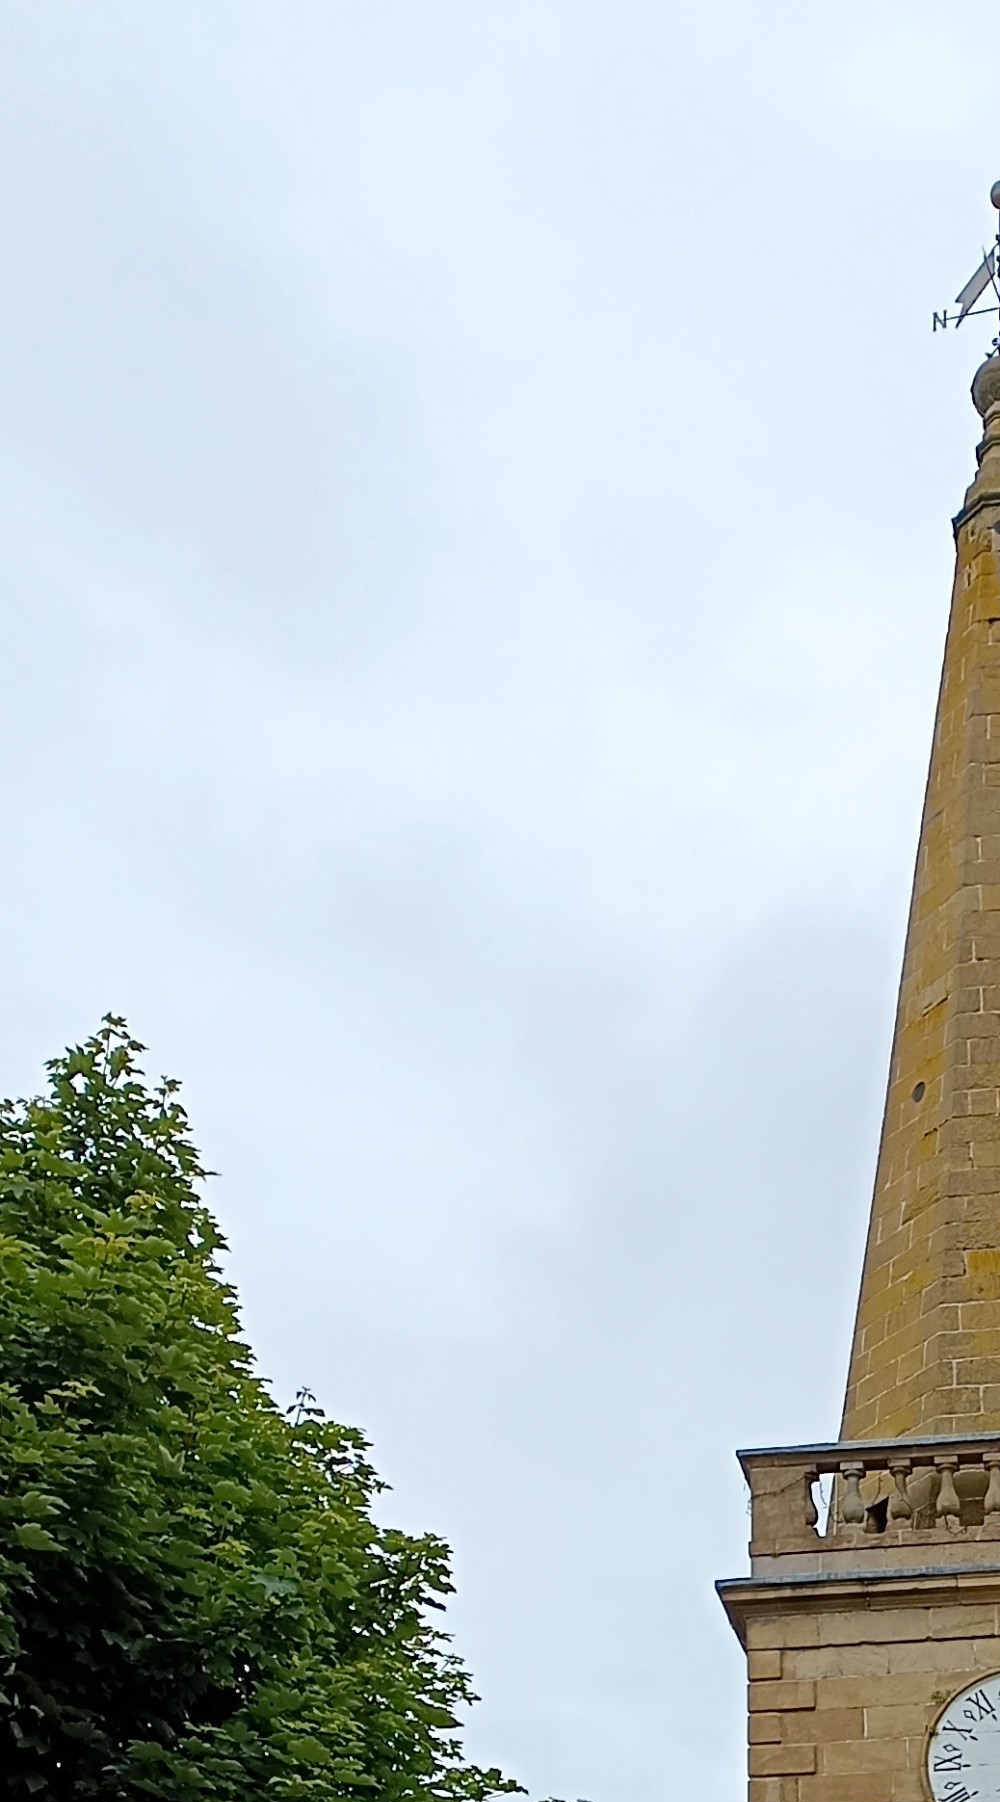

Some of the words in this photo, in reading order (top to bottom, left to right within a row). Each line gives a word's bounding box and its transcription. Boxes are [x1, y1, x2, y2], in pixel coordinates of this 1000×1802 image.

[933, 309, 948, 332] N
[965, 1689, 996, 1721] XI
[941, 1719, 973, 1741] X
[933, 1752, 963, 1773] IX
